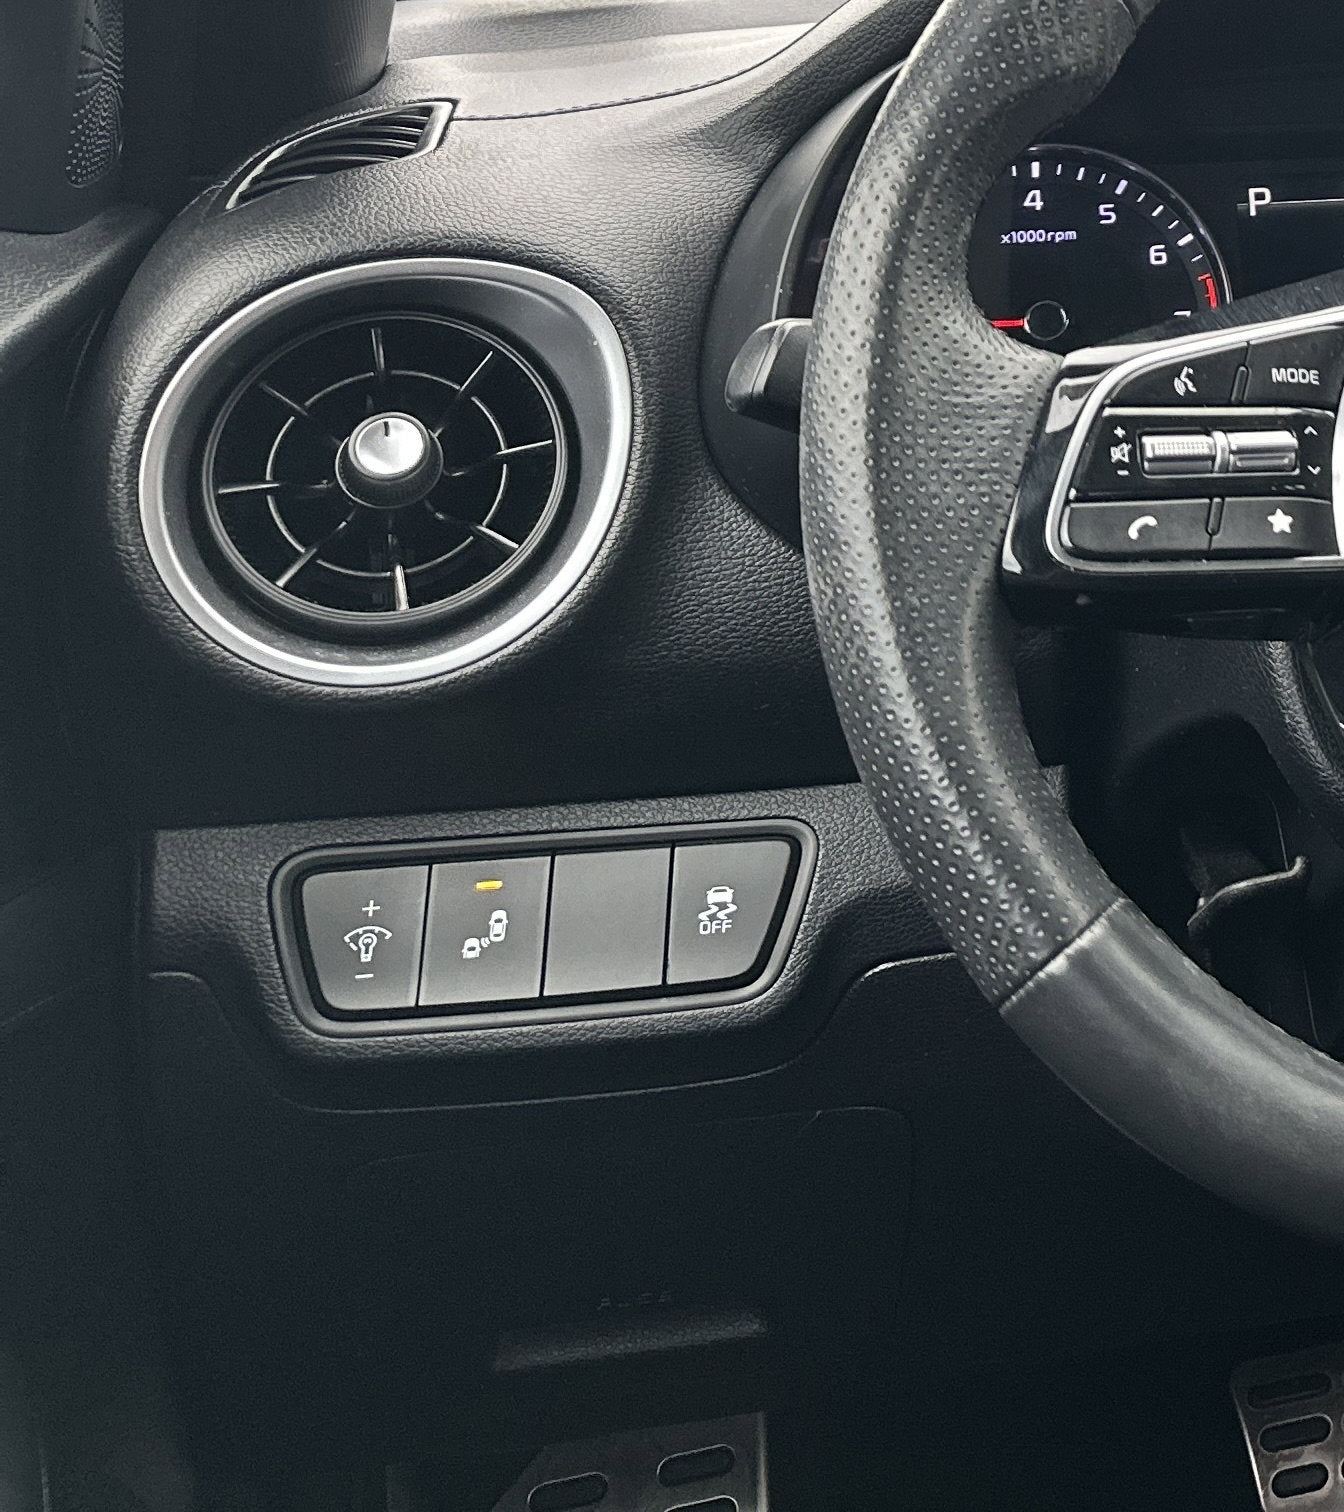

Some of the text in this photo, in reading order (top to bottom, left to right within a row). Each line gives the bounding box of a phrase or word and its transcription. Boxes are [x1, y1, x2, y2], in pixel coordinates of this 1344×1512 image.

[1022, 189, 1045, 211] 4
[1248, 187, 1272, 217] P
[1098, 203, 1117, 225] 5
[1149, 244, 1168, 266] 6
[1271, 367, 1320, 385] MODE
[699, 917, 734, 936] OFF
